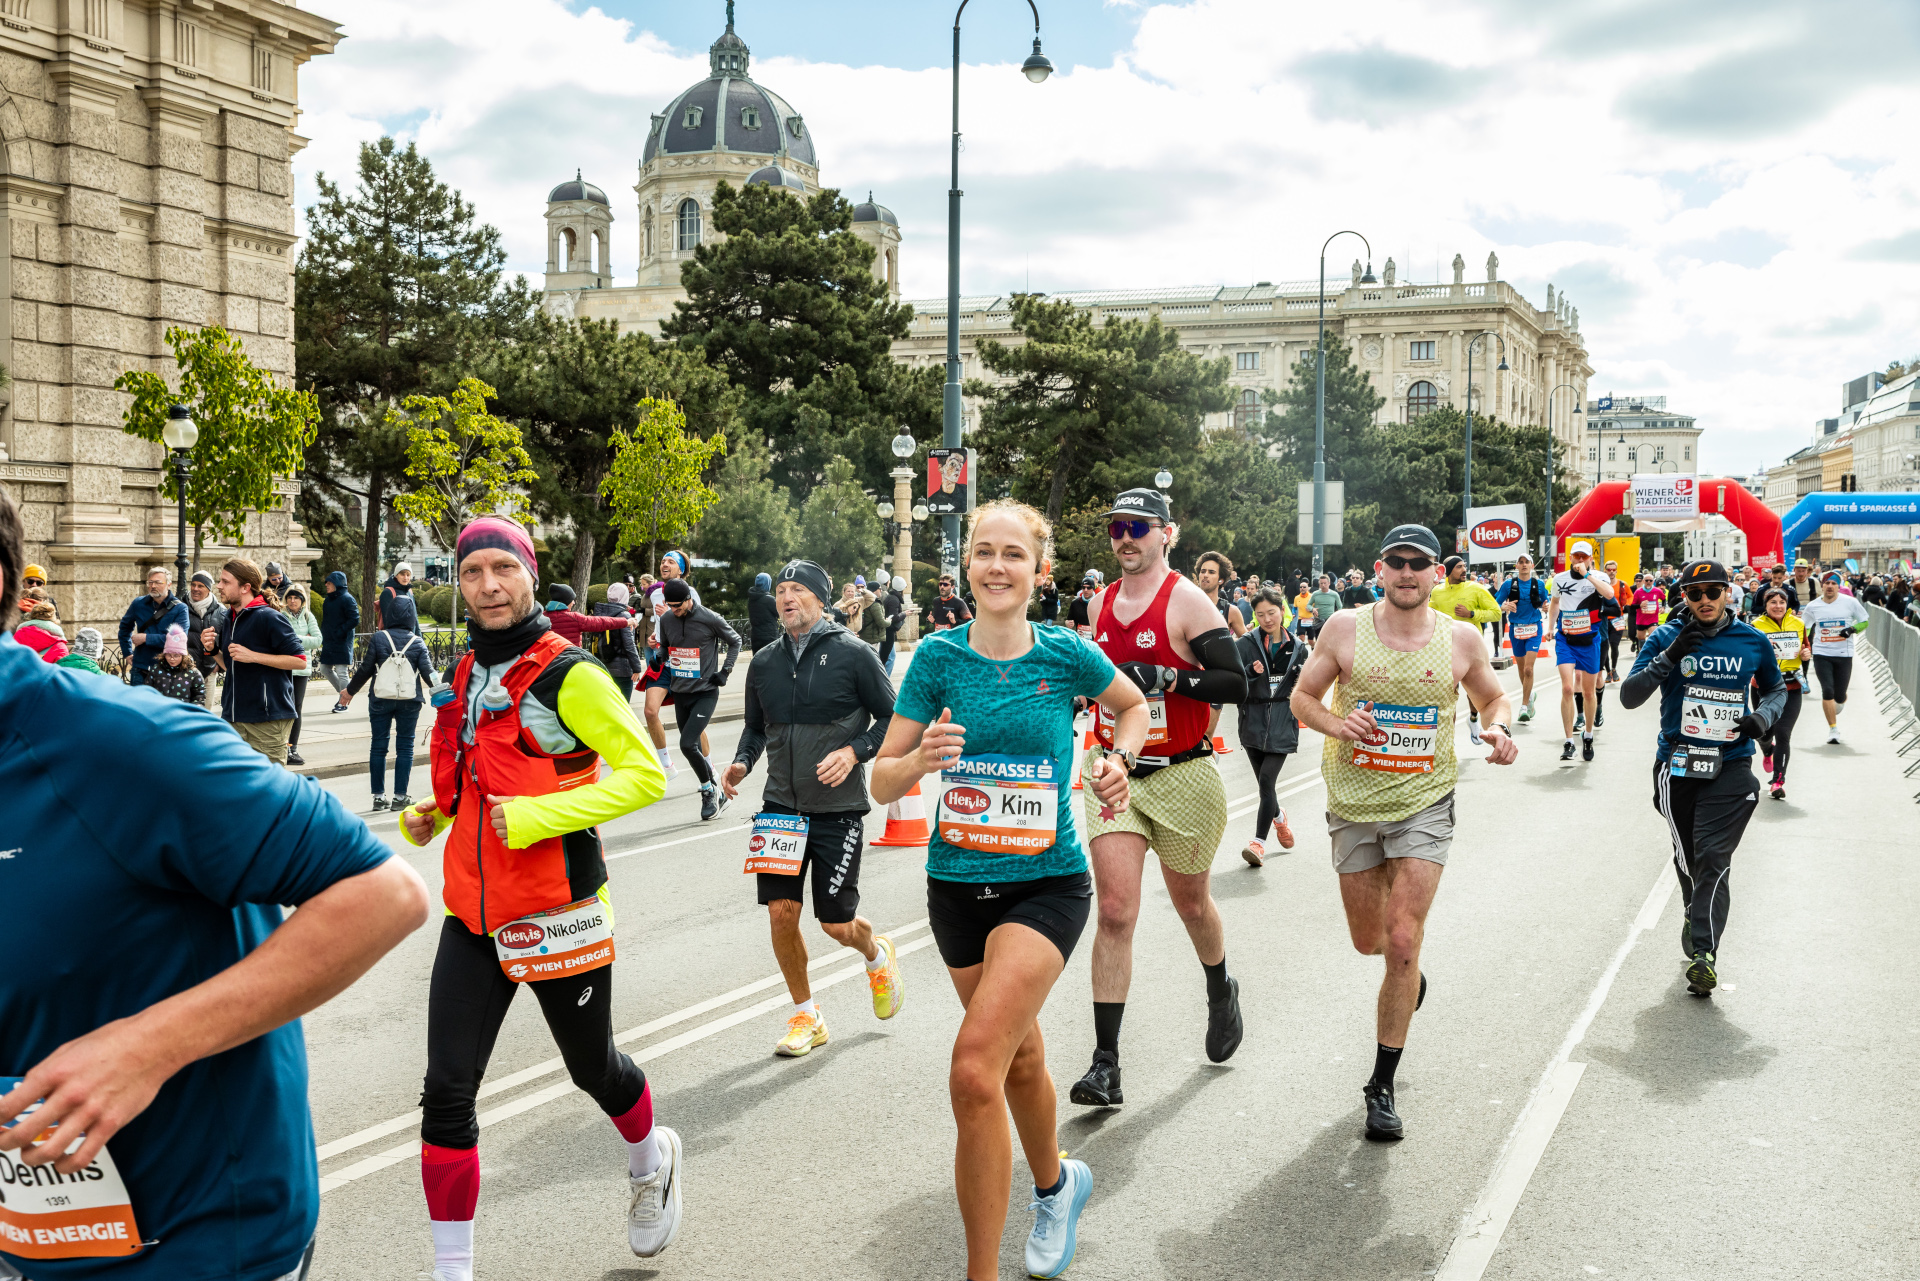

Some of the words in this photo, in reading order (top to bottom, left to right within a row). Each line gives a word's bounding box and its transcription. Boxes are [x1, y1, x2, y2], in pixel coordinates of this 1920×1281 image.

[1599, 400, 1610, 408] JP
[1635, 489, 1674, 497] WIENER
[1115, 496, 1144, 507] HOKA
[1636, 496, 1692, 506] STÄDTISCHE
[1824, 504, 1849, 512] ERSTE
[1860, 504, 1907, 513] SPARKASSE
[1475, 526, 1519, 542] Hervis
[1700, 656, 1742, 672] GTW
[1688, 687, 1743, 702] POWERADE
[1370, 708, 1423, 722] ARKASSE
[1713, 708, 1740, 721] 931B
[1146, 733, 1165, 741] RGIE
[1366, 732, 1387, 743] ervis
[1391, 732, 1431, 750] Derry
[1372, 758, 1395, 767] WIEN
[1396, 760, 1430, 768] ENERGIE
[1693, 761, 1714, 772] 931
[948, 791, 987, 808] Hervis
[1001, 793, 1042, 816] Kim
[753, 818, 795, 829] PARKASSE
[771, 838, 798, 852] Karl
[968, 832, 998, 844] WIEN
[1001, 834, 1050, 847] ENERGIE
[769, 862, 798, 870] ENERGIE
[829, 827, 860, 897] skinfit
[546, 915, 603, 939] Nikolaus
[502, 928, 542, 943] Hervis
[532, 960, 563, 973] WIEN
[565, 947, 611, 969] ENERGIE
[45, 1195, 71, 1206] 1391
[33, 1221, 129, 1245] ENERGIE
